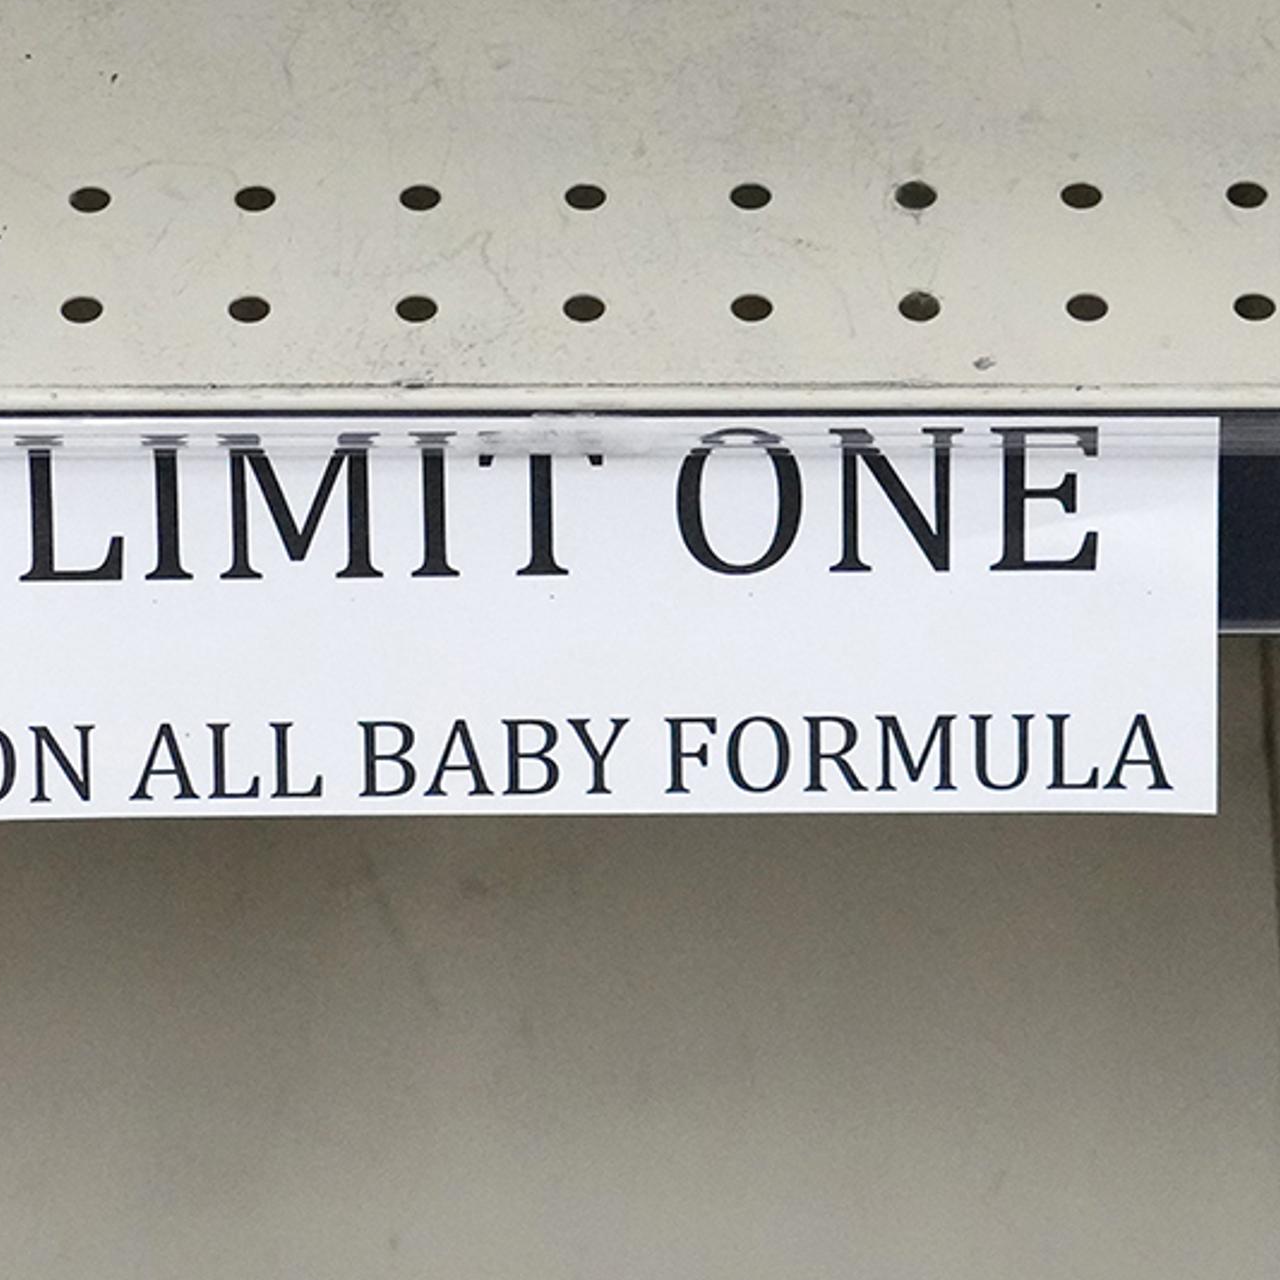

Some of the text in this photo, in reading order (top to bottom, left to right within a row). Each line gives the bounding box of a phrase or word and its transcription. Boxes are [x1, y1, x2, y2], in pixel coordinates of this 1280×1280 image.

[15, 426, 1101, 583] LIMIT ONE
[130, 719, 324, 801] ALL
[358, 717, 630, 797] BABY
[664, 713, 1174, 793] FORMULA
